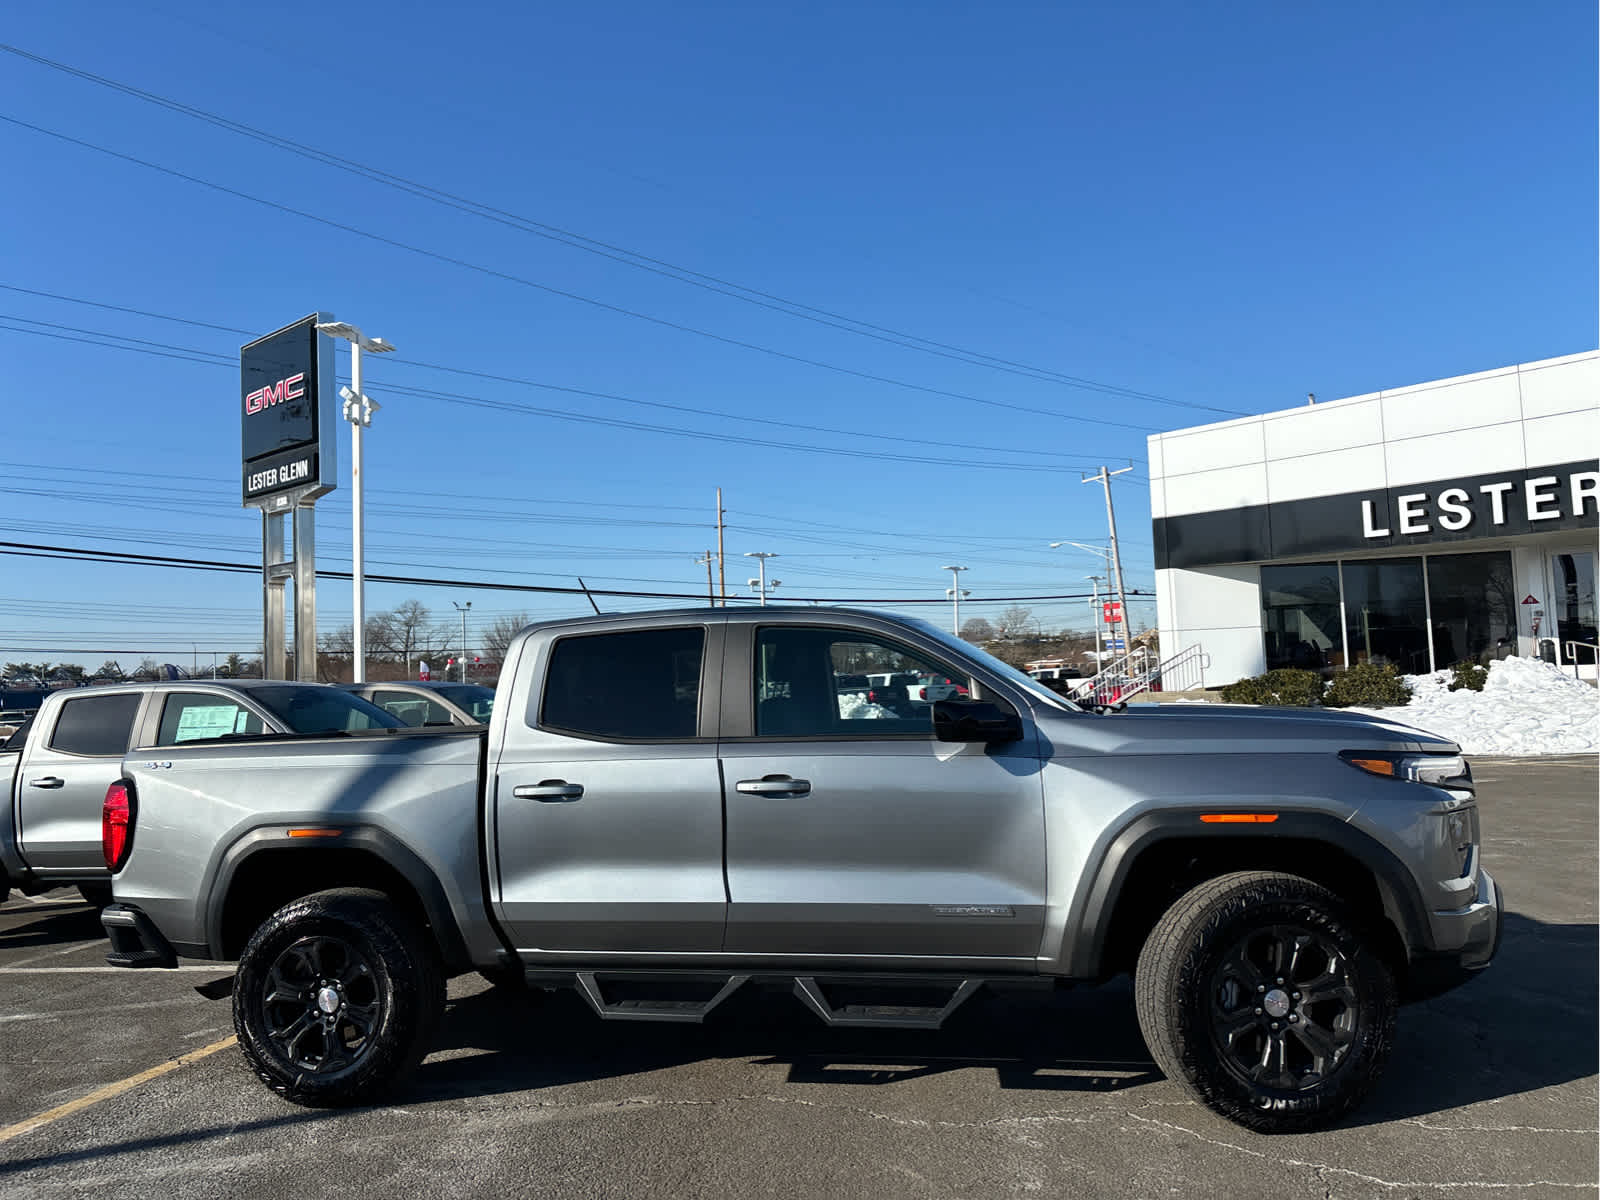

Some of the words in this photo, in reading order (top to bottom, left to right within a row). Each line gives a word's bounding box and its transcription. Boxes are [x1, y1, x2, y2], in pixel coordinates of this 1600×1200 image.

[246, 372, 304, 416] GMC
[248, 468, 277, 492] LESTER
[280, 459, 308, 483] GLENN
[1361, 471, 1600, 538] LESTER
